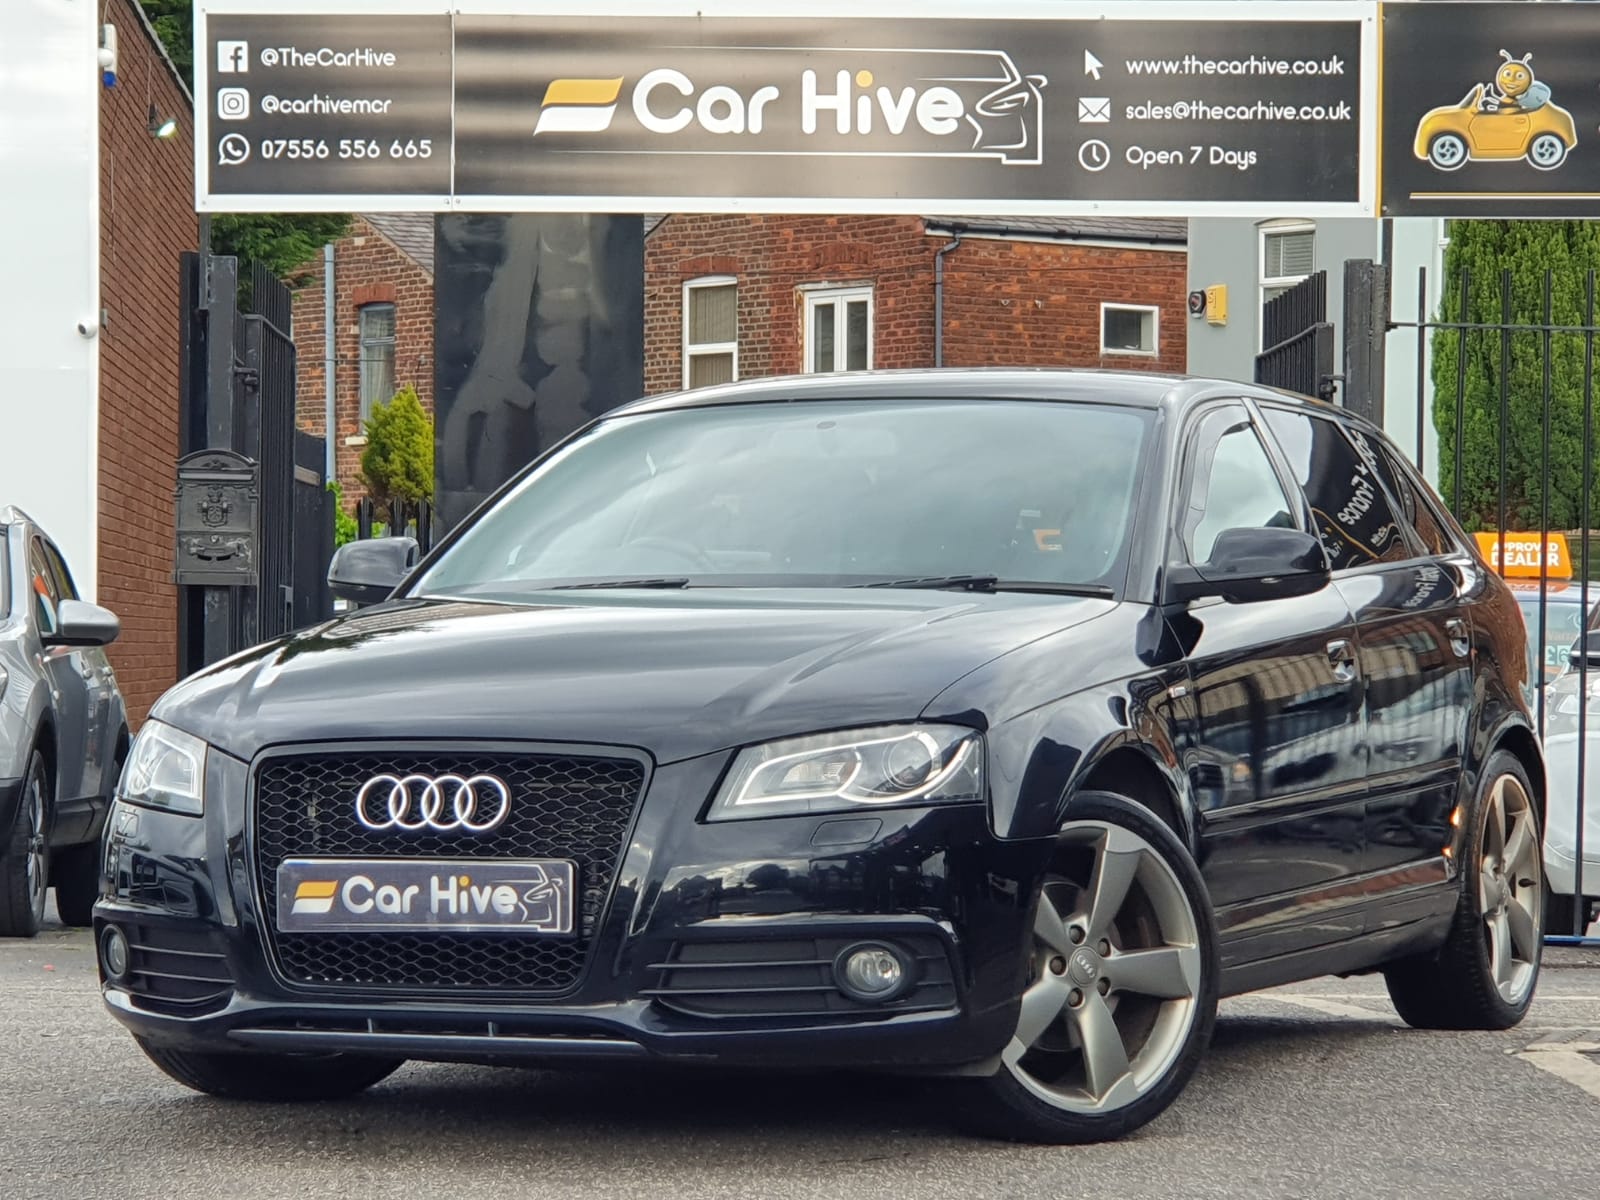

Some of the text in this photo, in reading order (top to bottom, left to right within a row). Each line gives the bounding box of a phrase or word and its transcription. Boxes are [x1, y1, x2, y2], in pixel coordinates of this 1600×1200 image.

[260, 47, 396, 67] @TheCarHive
[1125, 55, 1345, 76] www.thecarhive.co.uk
[261, 94, 392, 114] @carhivemcr
[632, 68, 965, 135] Car Hive
[1125, 100, 1352, 121] sales@thecarhive.co.uk
[262, 139, 433, 159] 07556 556 665
[1125, 146, 1257, 171] Open 7 Days
[341, 875, 518, 915] Car Hive
